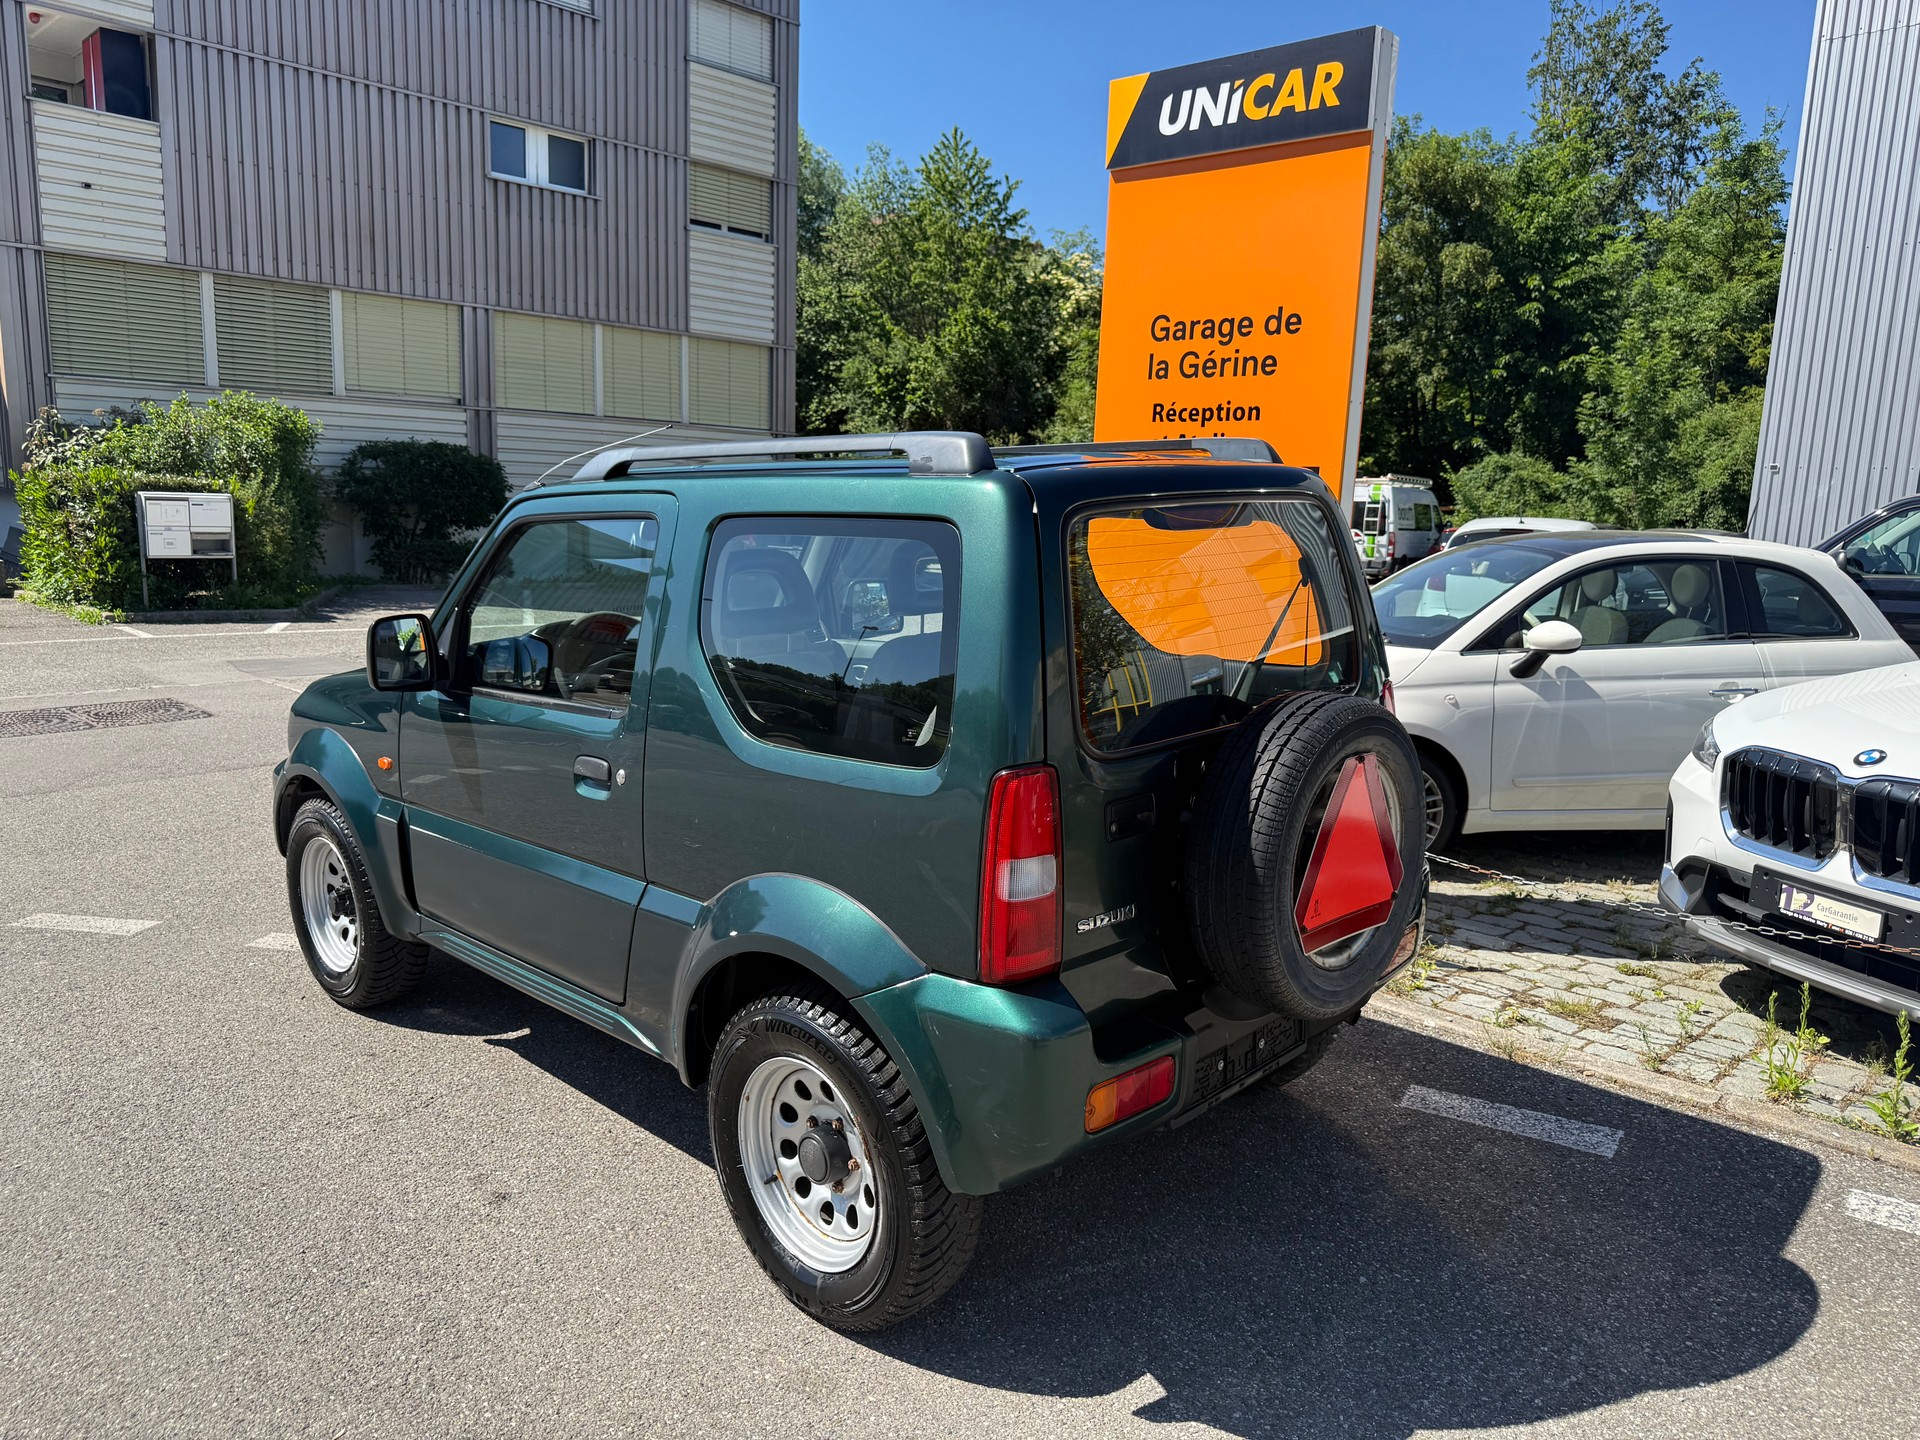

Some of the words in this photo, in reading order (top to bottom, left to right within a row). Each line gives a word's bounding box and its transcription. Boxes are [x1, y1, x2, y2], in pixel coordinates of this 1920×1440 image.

[1150, 314, 1254, 346] Garage
[1264, 306, 1302, 335] de
[1147, 353, 1169, 380] la
[1179, 349, 1278, 379] Gérine
[1151, 400, 1261, 428] Réception
[1077, 904, 1136, 933] SUZUKI
[1816, 902, 1859, 923] CarGarantie
[762, 1019, 838, 1067] WINGUARD
